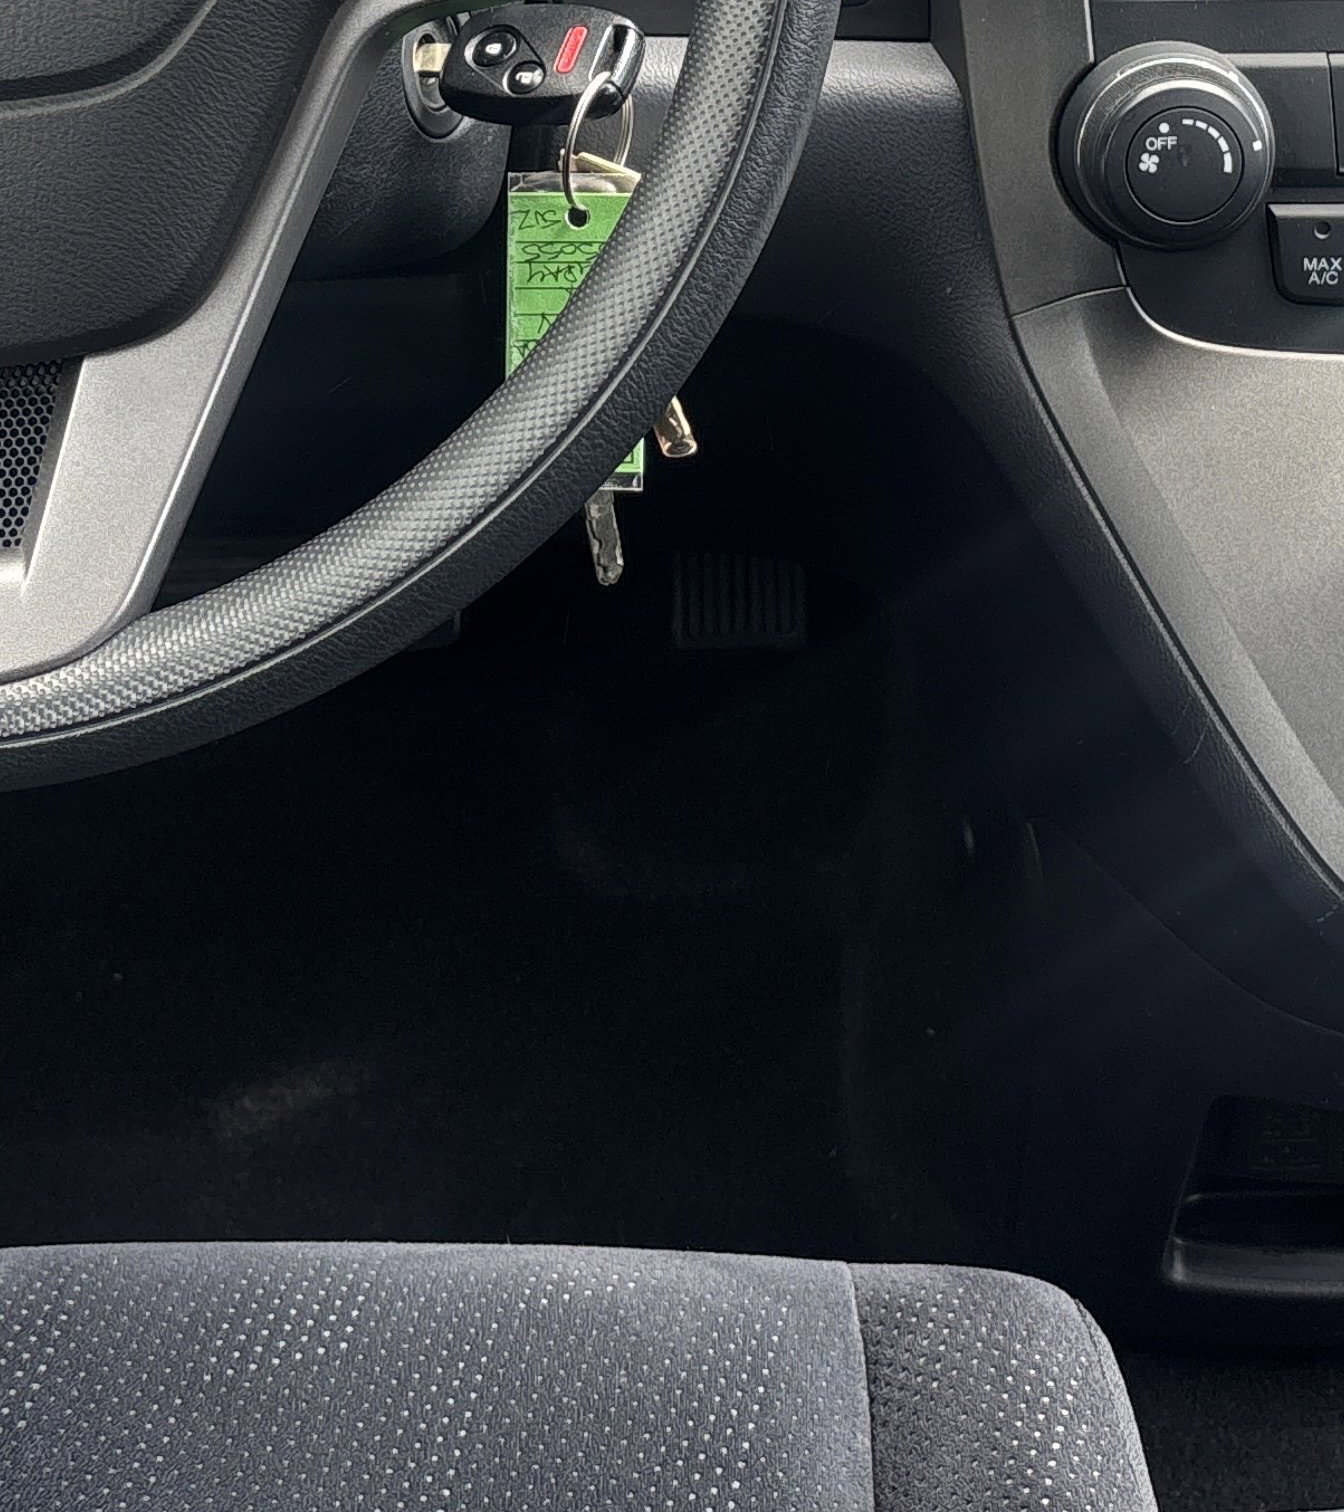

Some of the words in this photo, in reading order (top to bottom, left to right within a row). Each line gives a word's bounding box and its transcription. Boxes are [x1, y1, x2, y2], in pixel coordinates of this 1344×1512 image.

[1146, 136, 1177, 151] OFF
[1303, 258, 1342, 272] MAX
[1308, 271, 1338, 285] A/C
